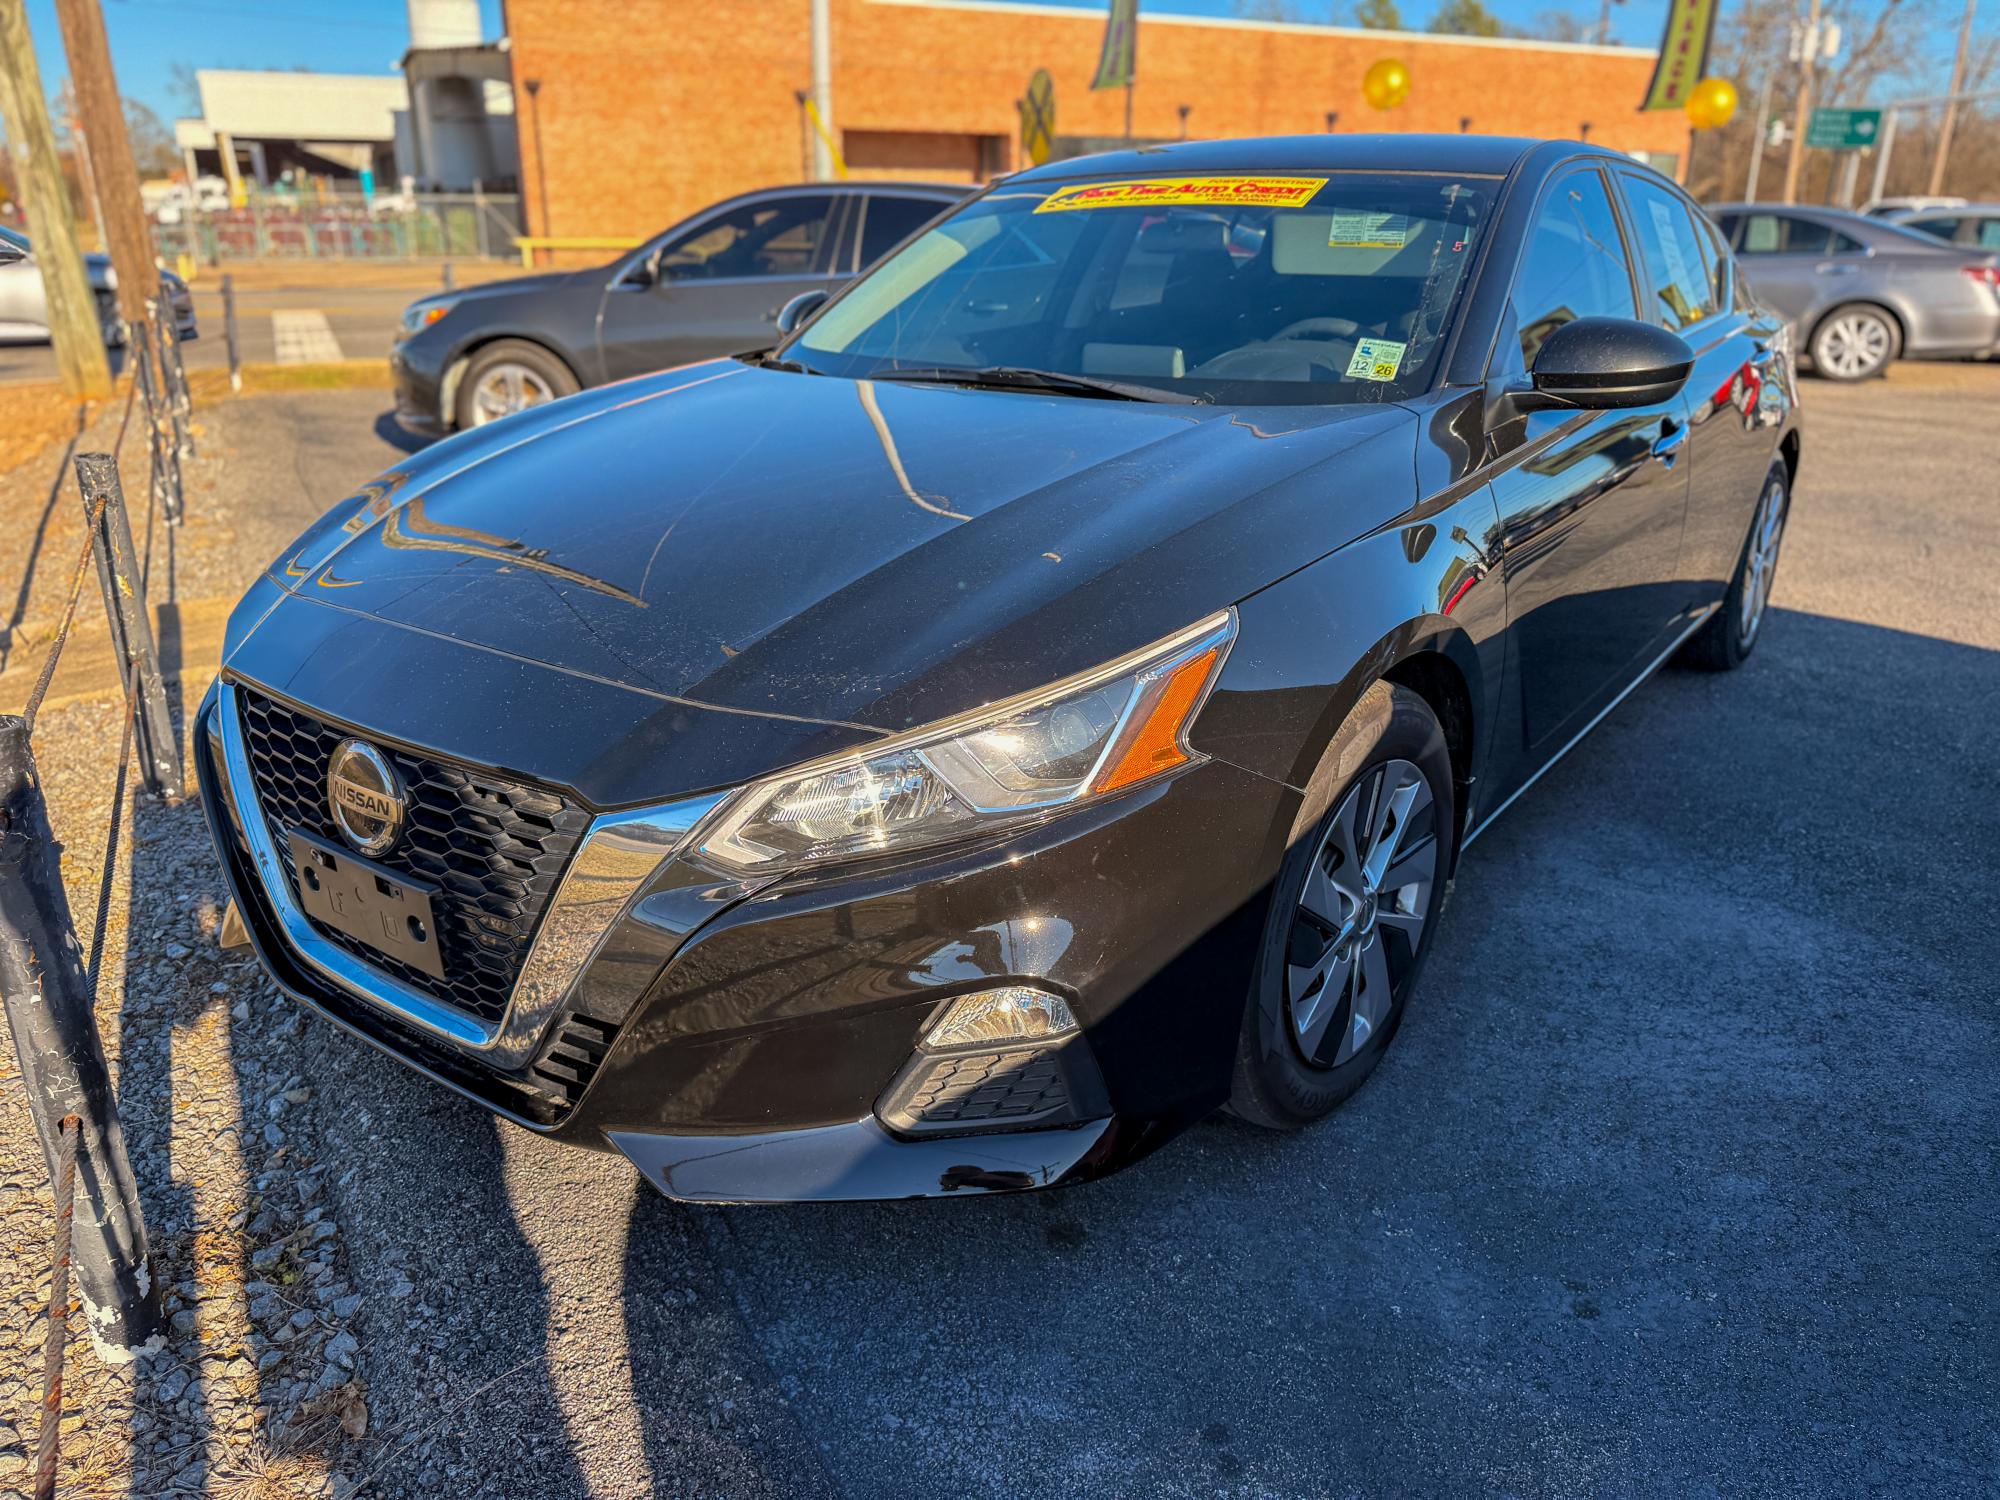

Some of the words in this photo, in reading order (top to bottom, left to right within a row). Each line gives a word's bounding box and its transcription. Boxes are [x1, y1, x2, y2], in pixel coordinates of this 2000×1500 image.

[1353, 360, 1369, 371] 12
[1375, 364, 1393, 376] 26
[334, 780, 390, 816] NISSAN
